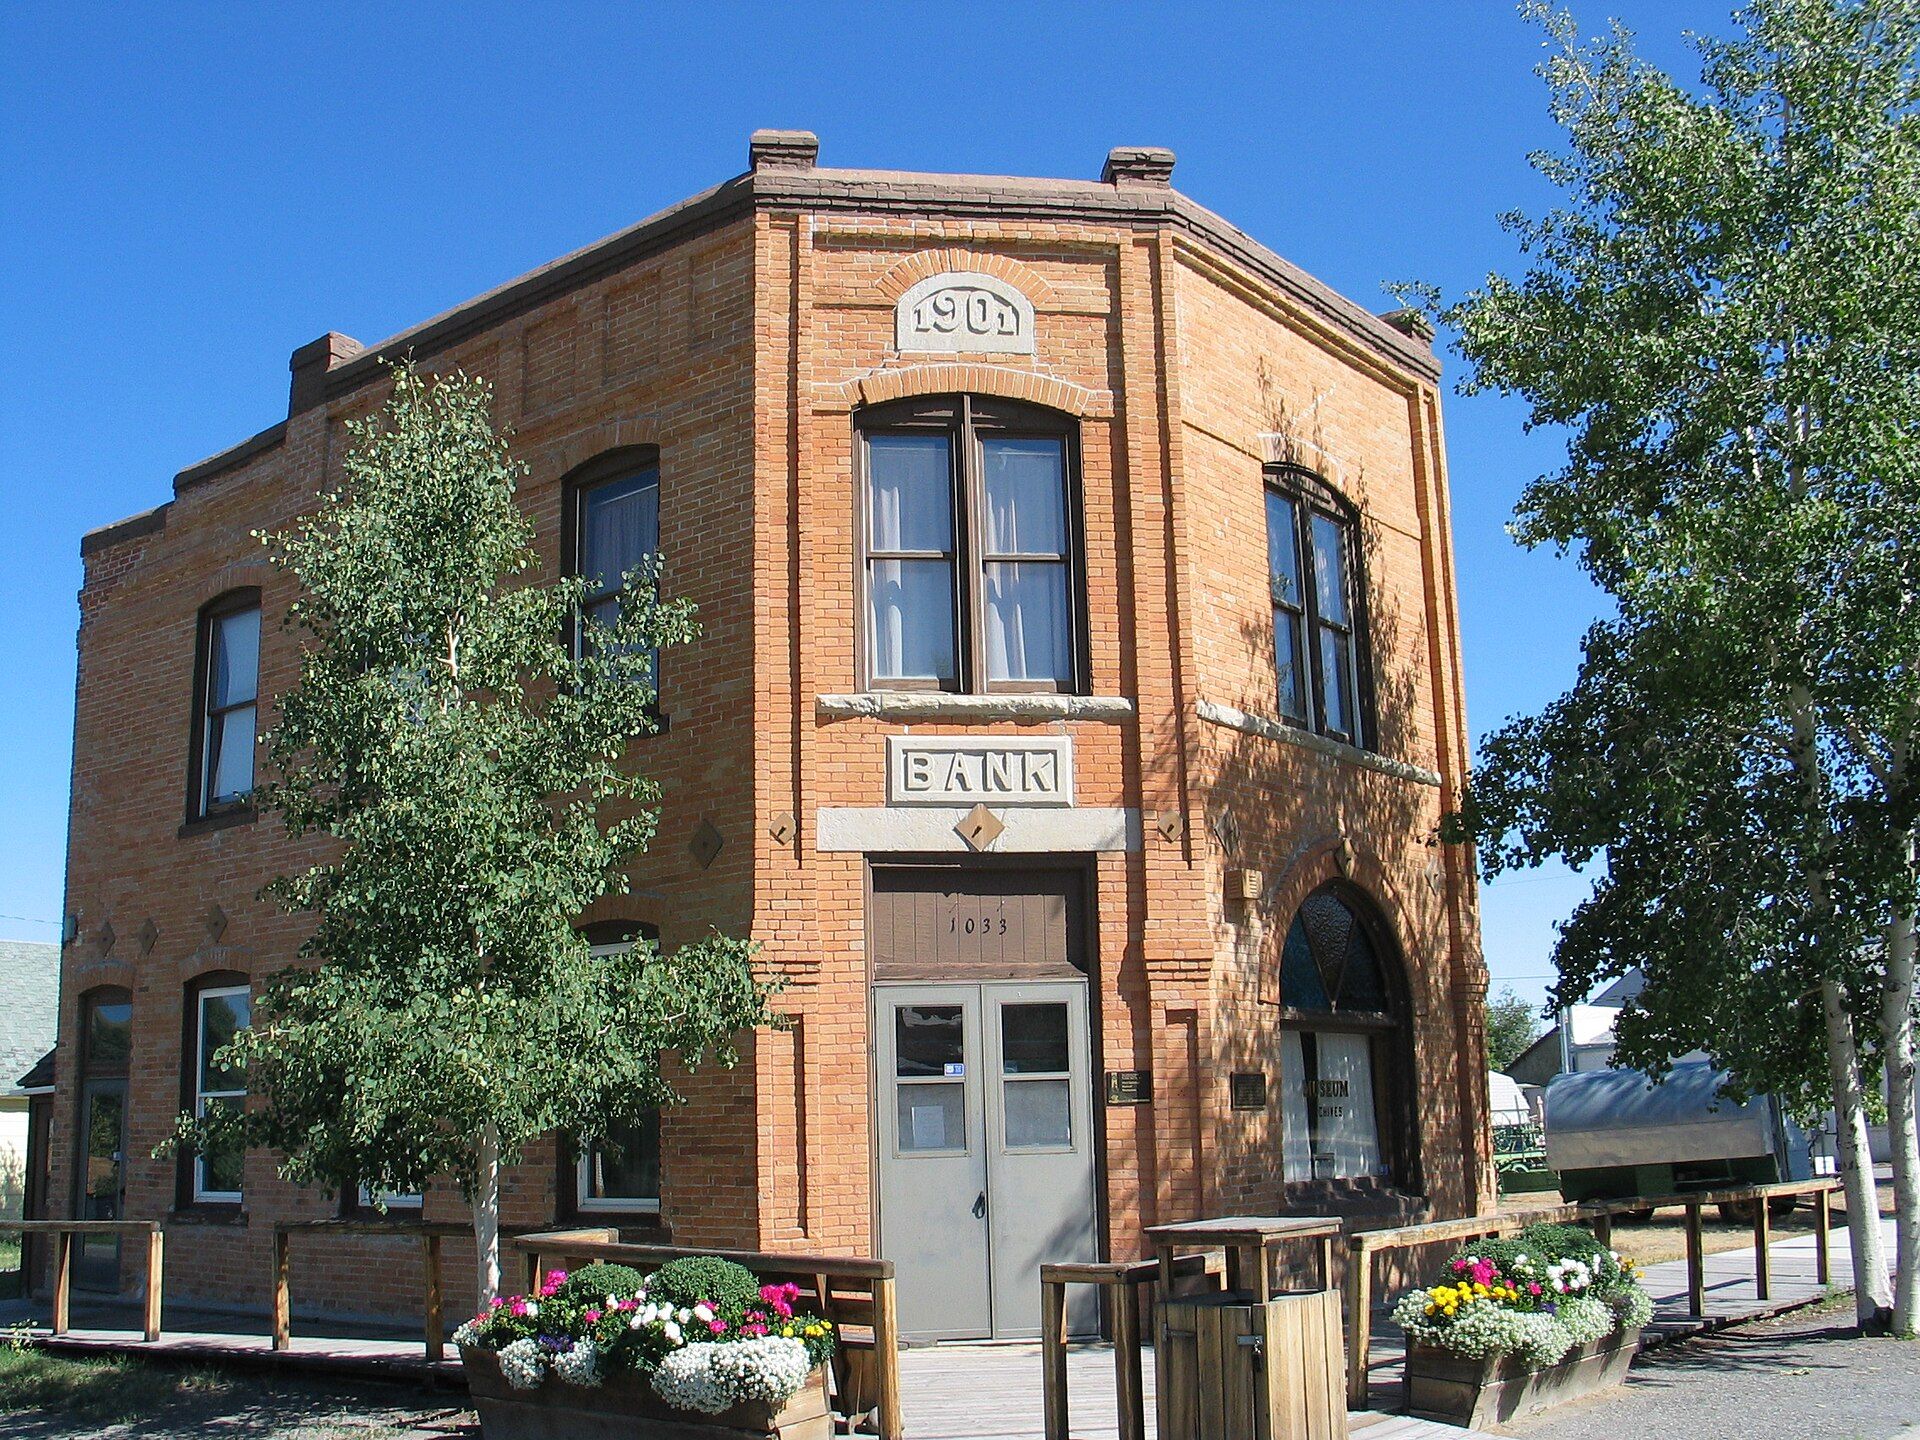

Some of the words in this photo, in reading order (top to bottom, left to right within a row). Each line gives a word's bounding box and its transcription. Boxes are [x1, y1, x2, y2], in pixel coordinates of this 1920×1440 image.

[912, 288, 1015, 334] 1901
[905, 752, 1053, 791] BANK
[950, 918, 1007, 934] 1033
